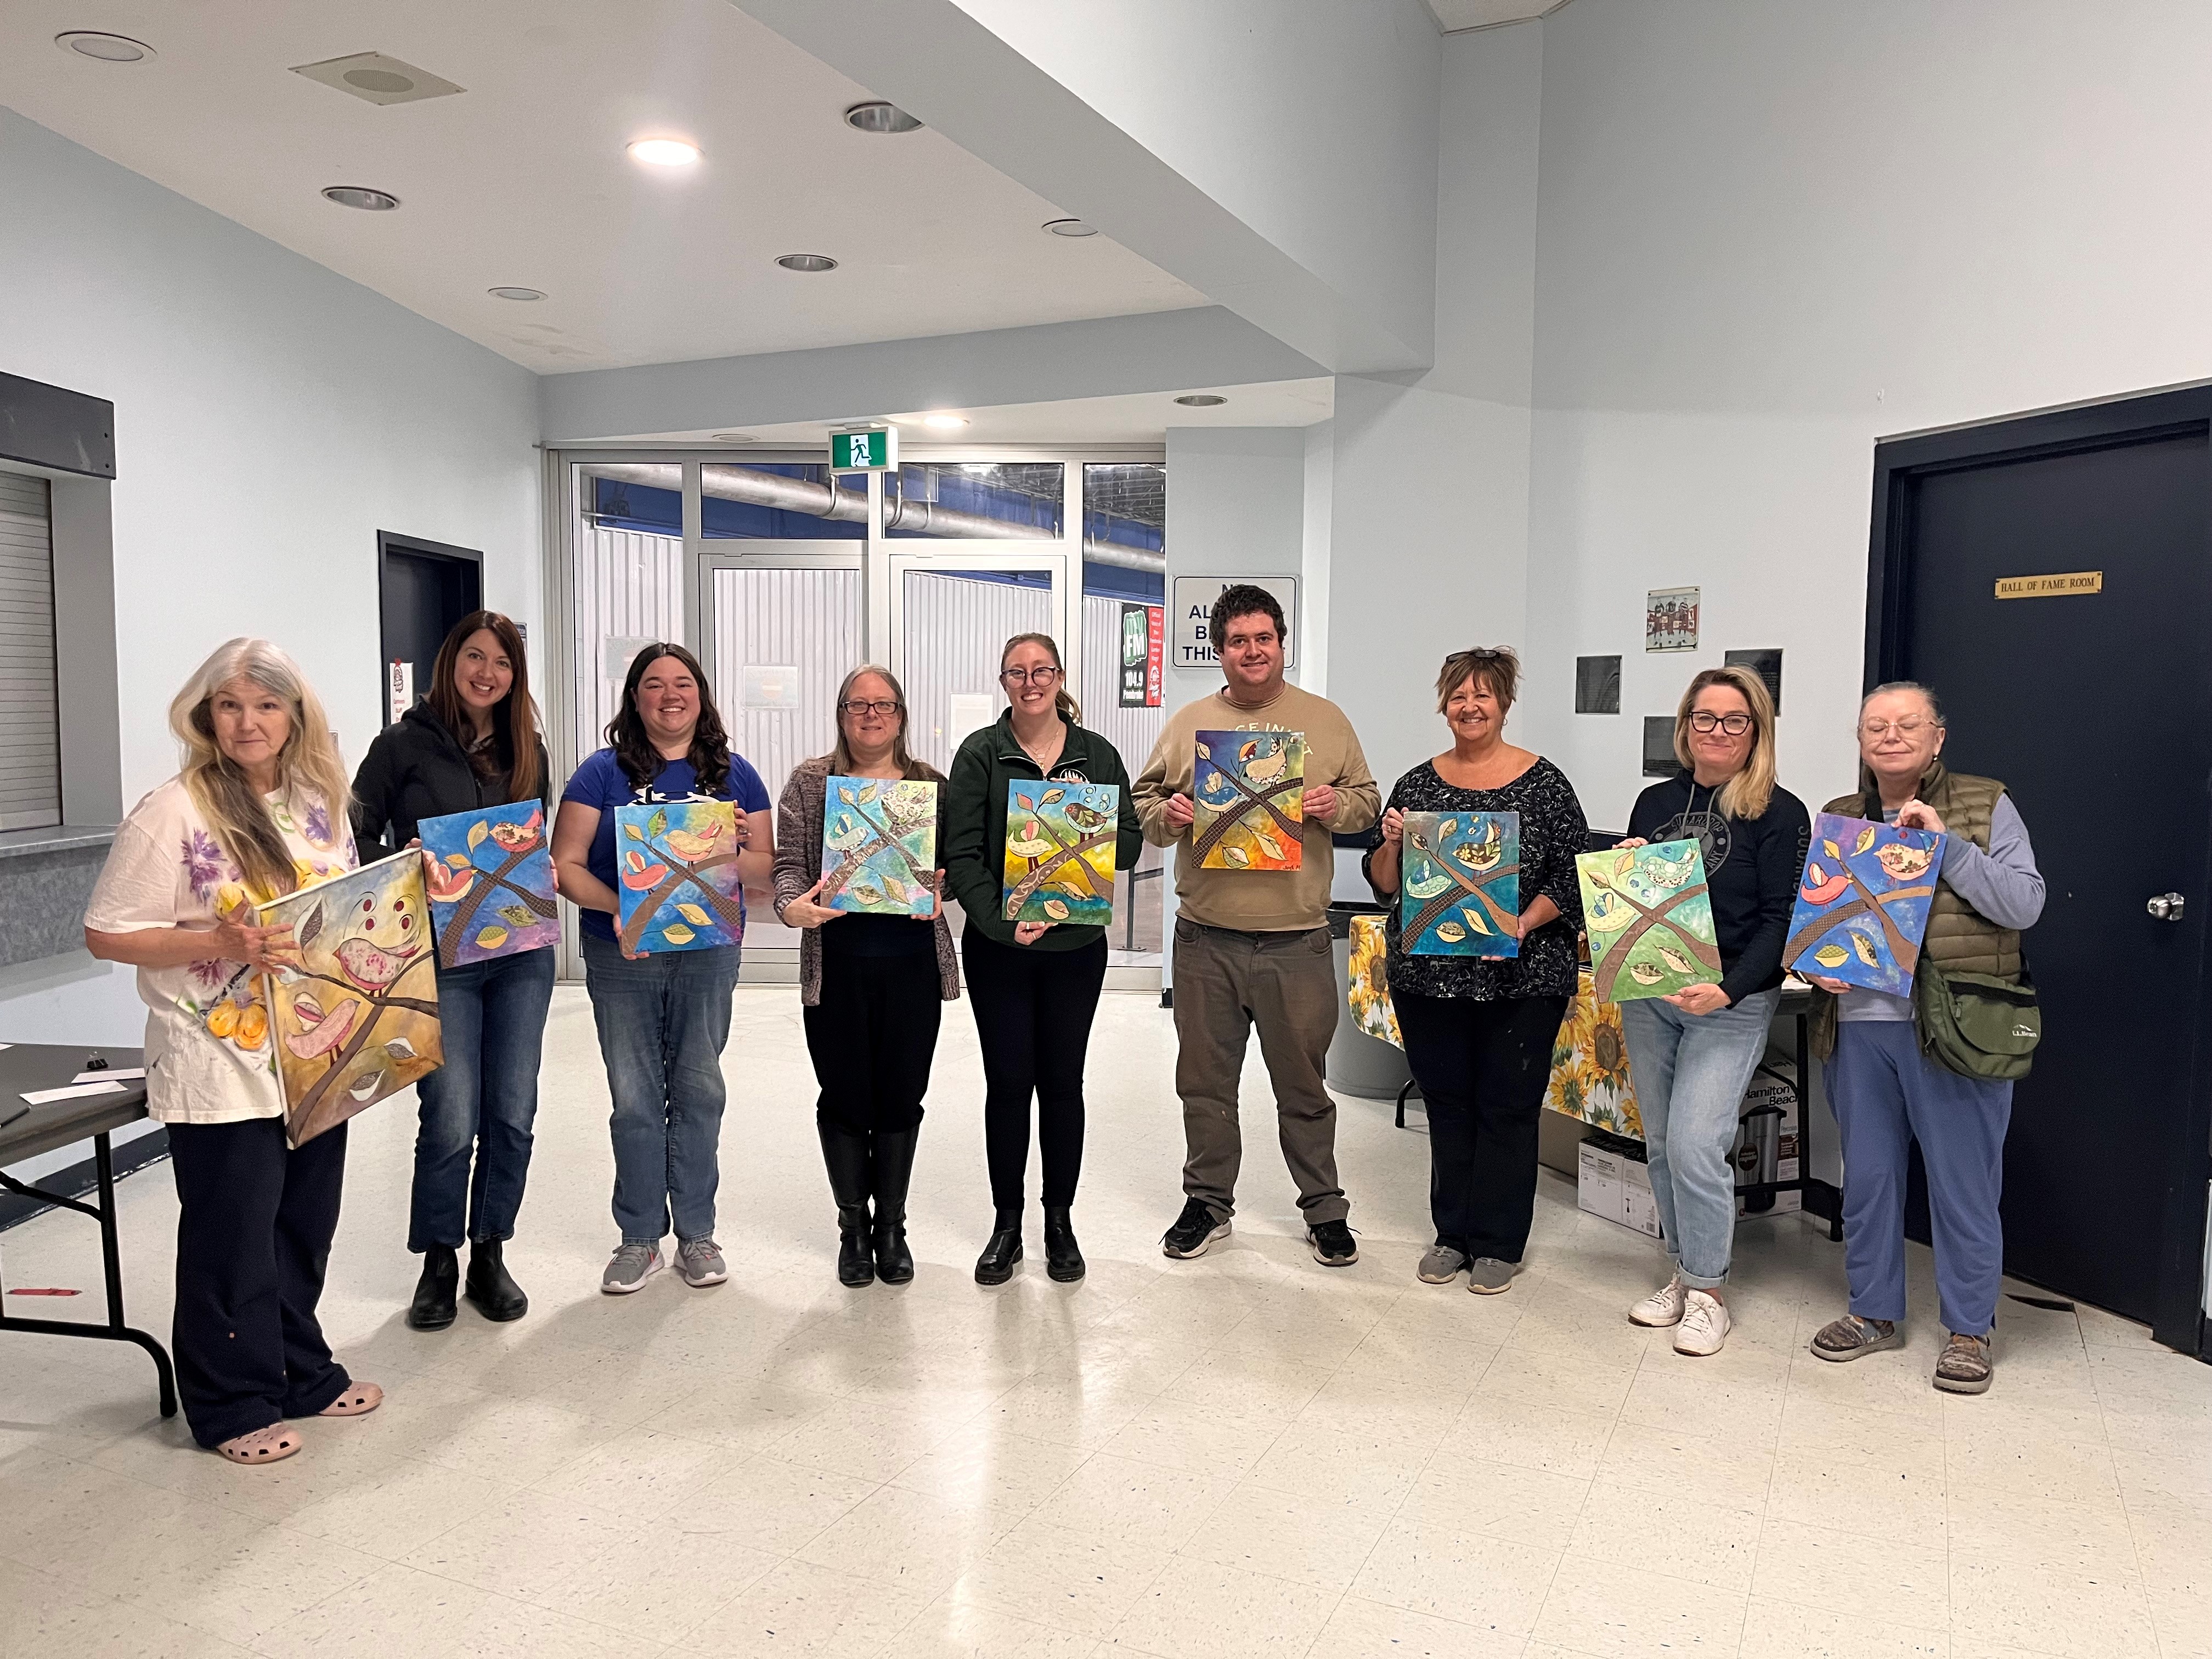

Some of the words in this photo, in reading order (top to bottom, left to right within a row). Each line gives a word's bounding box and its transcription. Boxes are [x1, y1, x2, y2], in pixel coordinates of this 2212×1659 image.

[2001, 582, 2023, 592] HALL
[2027, 581, 2038, 590] OF
[2042, 579, 2065, 590] FAME
[2070, 577, 2095, 588] ROOM
[1189, 605, 1211, 619] AL
[1195, 626, 1212, 640] B
[1126, 633, 1145, 658] FM
[1125, 671, 1143, 687] 104.9
[1228, 722, 1259, 732] CE
[1704, 850, 1724, 869] ANY
[1745, 1086, 1790, 1099] Hamilton
